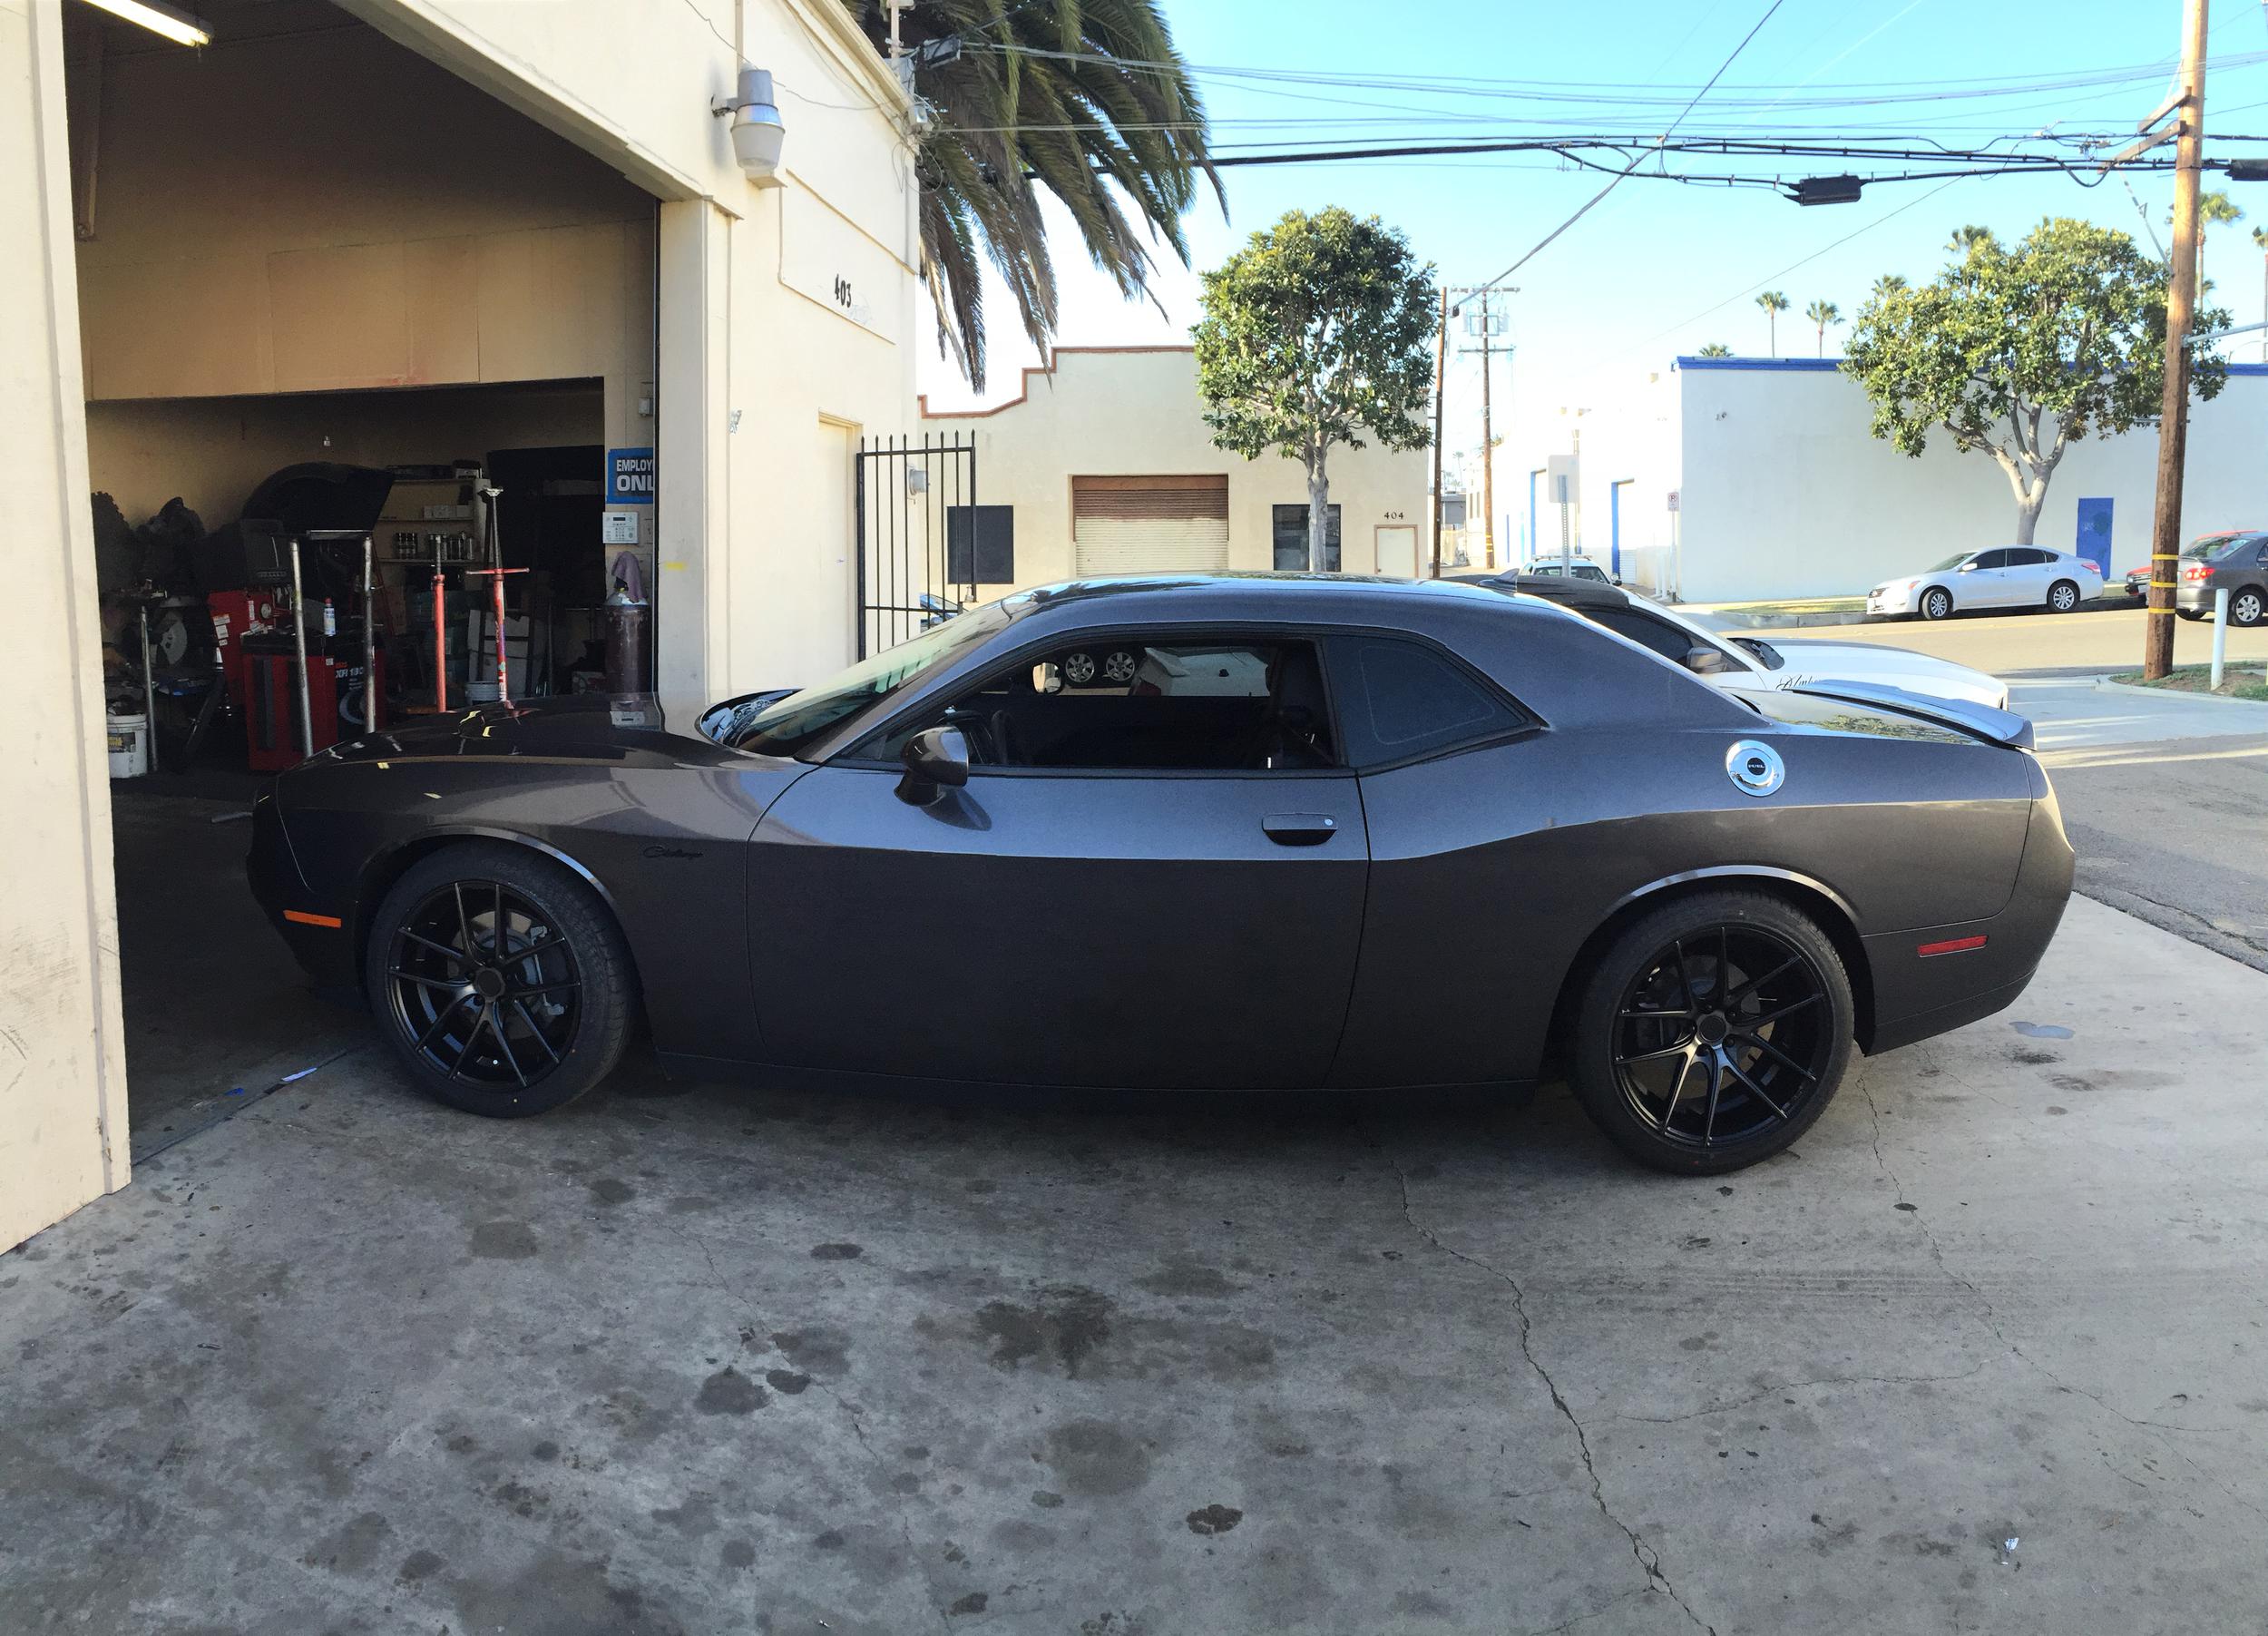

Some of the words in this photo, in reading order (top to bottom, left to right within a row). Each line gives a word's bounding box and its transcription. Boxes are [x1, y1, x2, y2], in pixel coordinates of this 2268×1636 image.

[835, 273, 852, 309] 403
[617, 459, 654, 472] EMPLOY
[1383, 512, 1404, 520] 404
